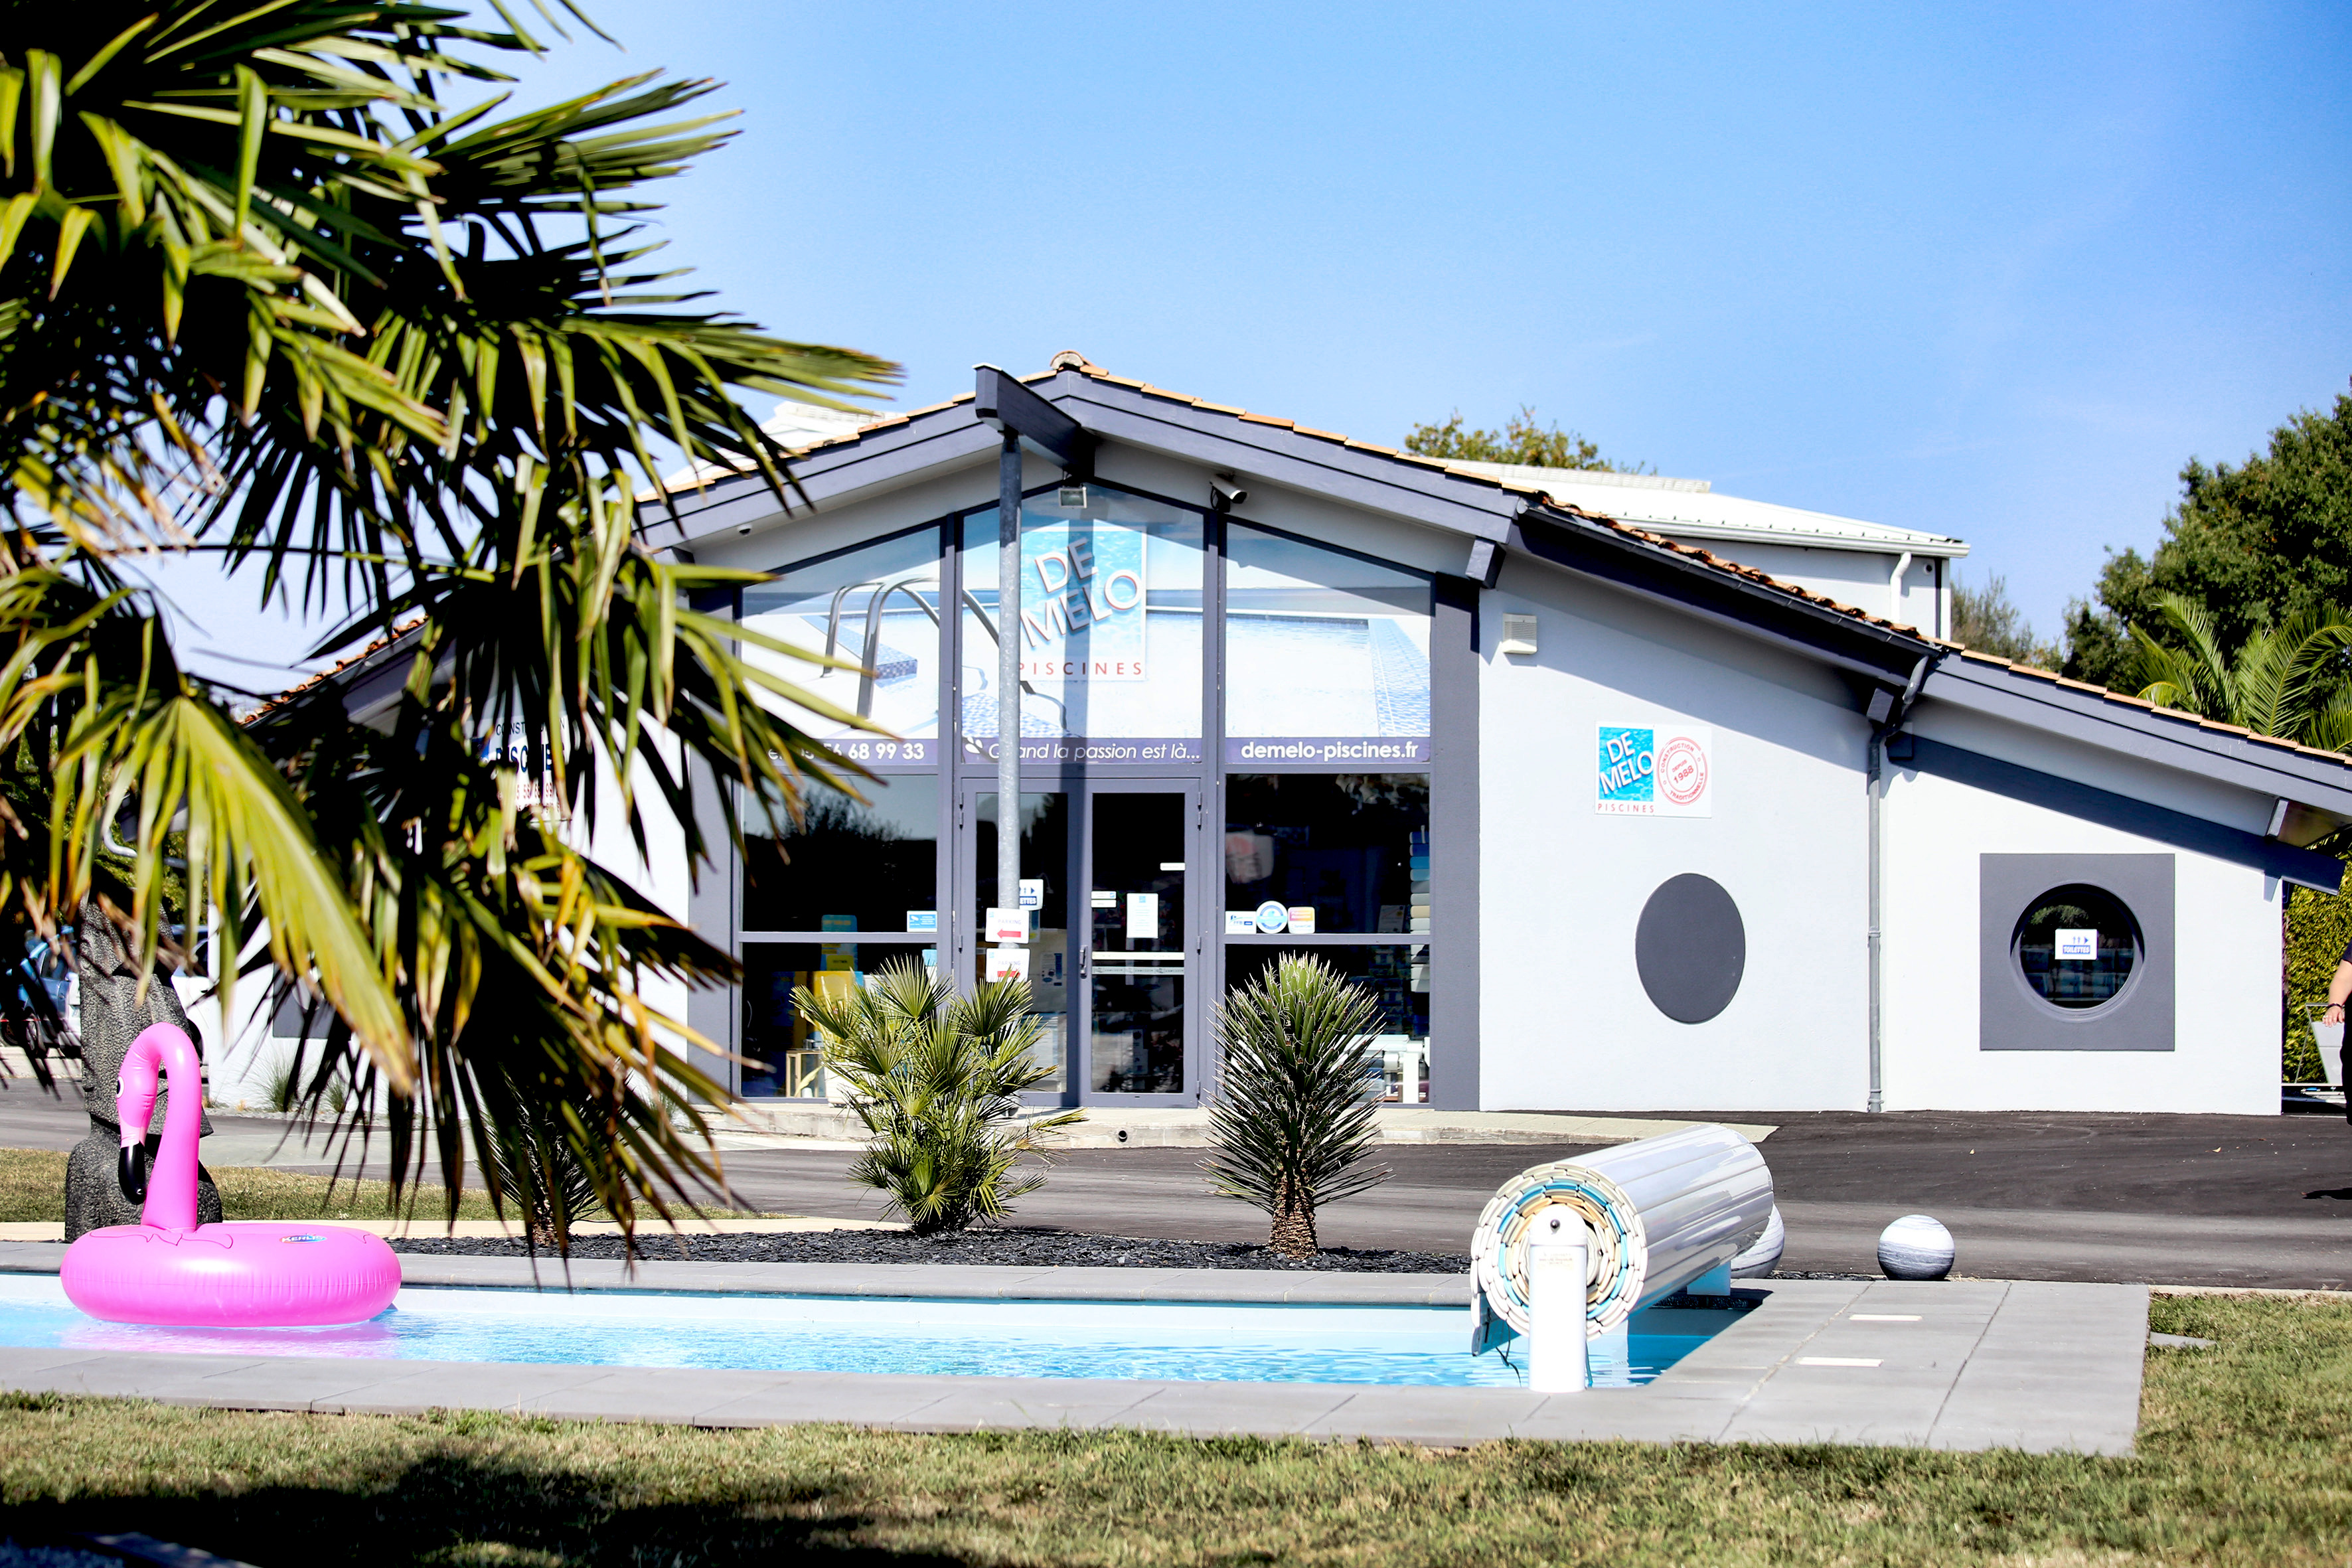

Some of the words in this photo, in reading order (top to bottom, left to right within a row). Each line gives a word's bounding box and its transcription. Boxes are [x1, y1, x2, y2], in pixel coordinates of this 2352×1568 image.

[1035, 537, 1099, 593] DE
[1020, 570, 1142, 647] MELO
[848, 743, 870, 760] 68
[876, 743, 897, 760] 99
[902, 743, 925, 760] 33
[988, 743, 1050, 759] Qand
[1054, 743, 1068, 759] la
[1073, 743, 1137, 761] passion
[1142, 745, 1166, 759] est
[1170, 743, 1200, 759] là...
[1241, 741, 1419, 761] demelo-piscines.fr
[1606, 731, 1635, 763] DE
[1660, 743, 1694, 773] CONSTRUCTION
[1599, 751, 1654, 795] MELO
[1674, 765, 1694, 783] 1988
[1598, 803, 1654, 813] PISCINES
